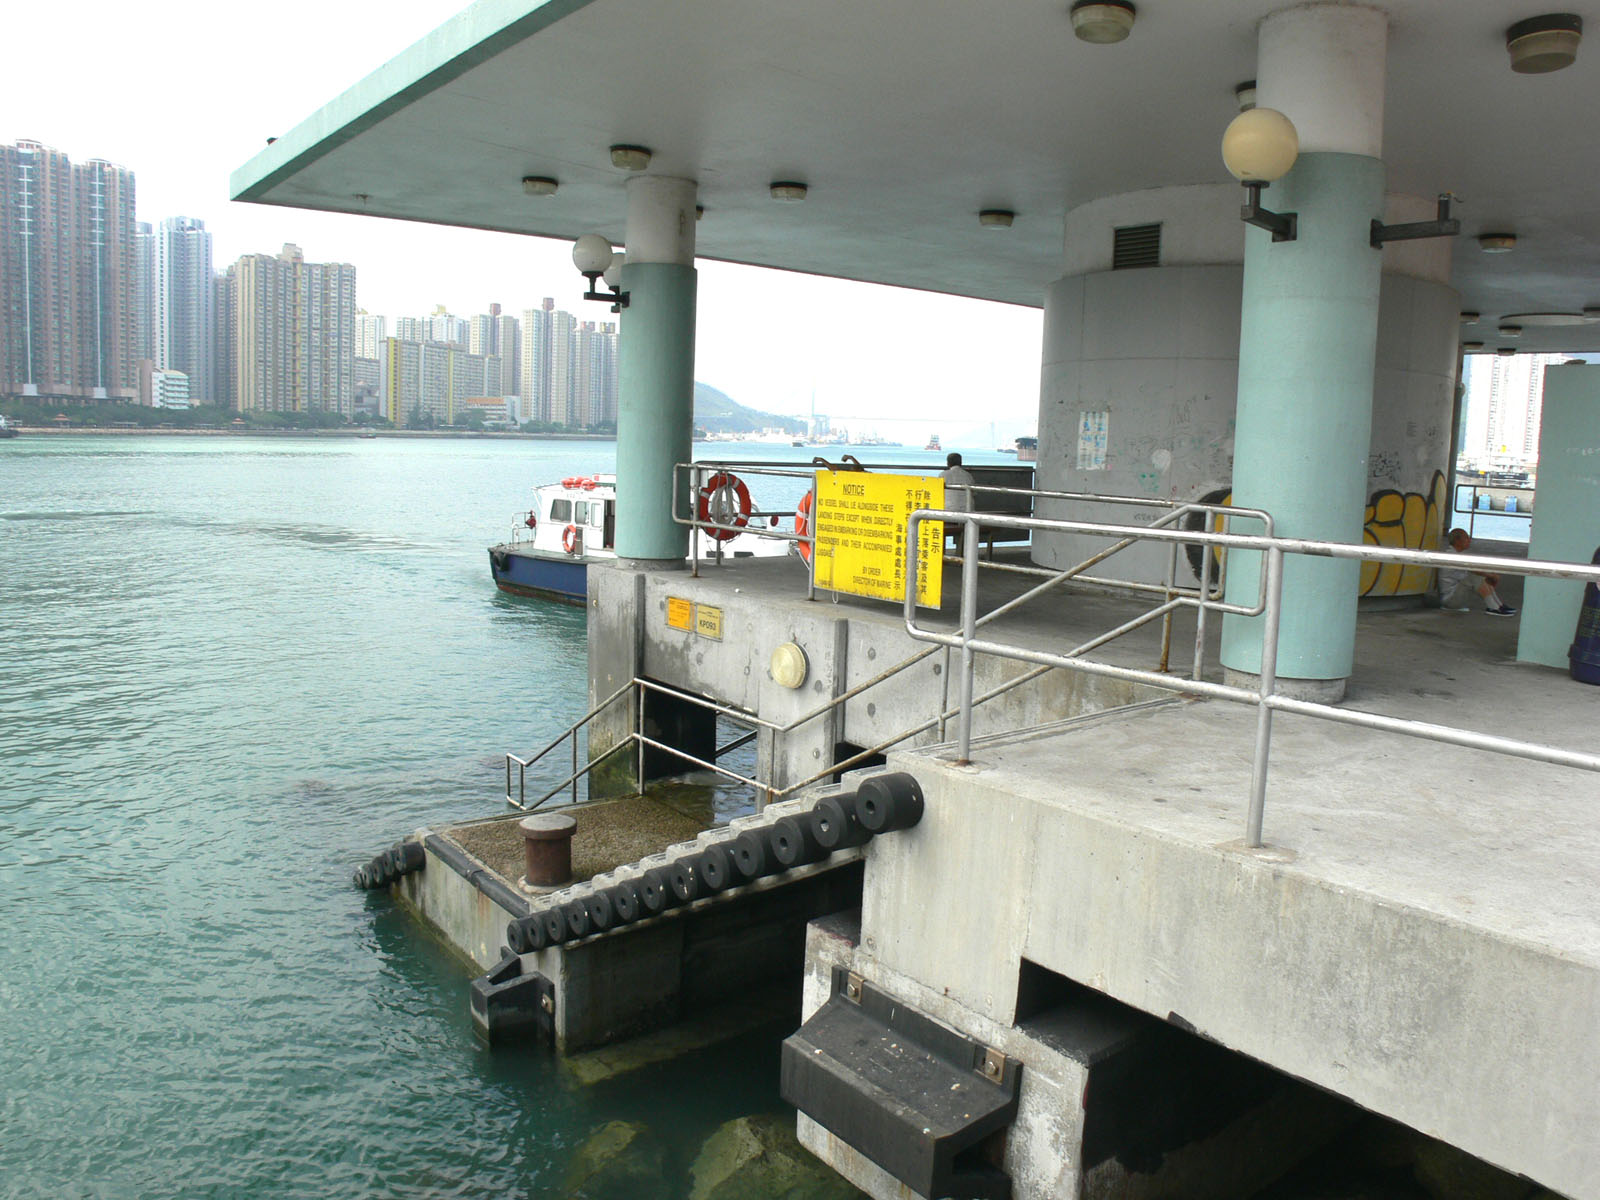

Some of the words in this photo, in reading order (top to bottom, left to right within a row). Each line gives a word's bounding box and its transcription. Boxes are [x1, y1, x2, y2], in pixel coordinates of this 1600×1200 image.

[843, 484, 864, 495] NOTICE
[825, 499, 837, 507] VESSEL
[839, 500, 849, 508] SHALL
[858, 502, 878, 511] ALONGSIDE
[880, 504, 894, 512] THESE
[818, 511, 832, 519] LANDING
[834, 512, 845, 521] STEPS
[846, 514, 860, 522] EXCEPT
[861, 516, 872, 524] WHEN
[873, 517, 893, 526] DIRECTLY
[817, 523, 833, 532] ENGAGED
[837, 526, 857, 536] EMBARKING
[864, 528, 893, 539] DISEMBARKING
[817, 536, 840, 546] PASSENGERS
[851, 540, 861, 548] THEIR
[863, 542, 892, 553] ACCOMPANIED
[931, 527, 940, 553] 告示
[868, 567, 881, 576] ORDER
[853, 576, 871, 585] DIRECTOR
[876, 580, 892, 589] MARINE
